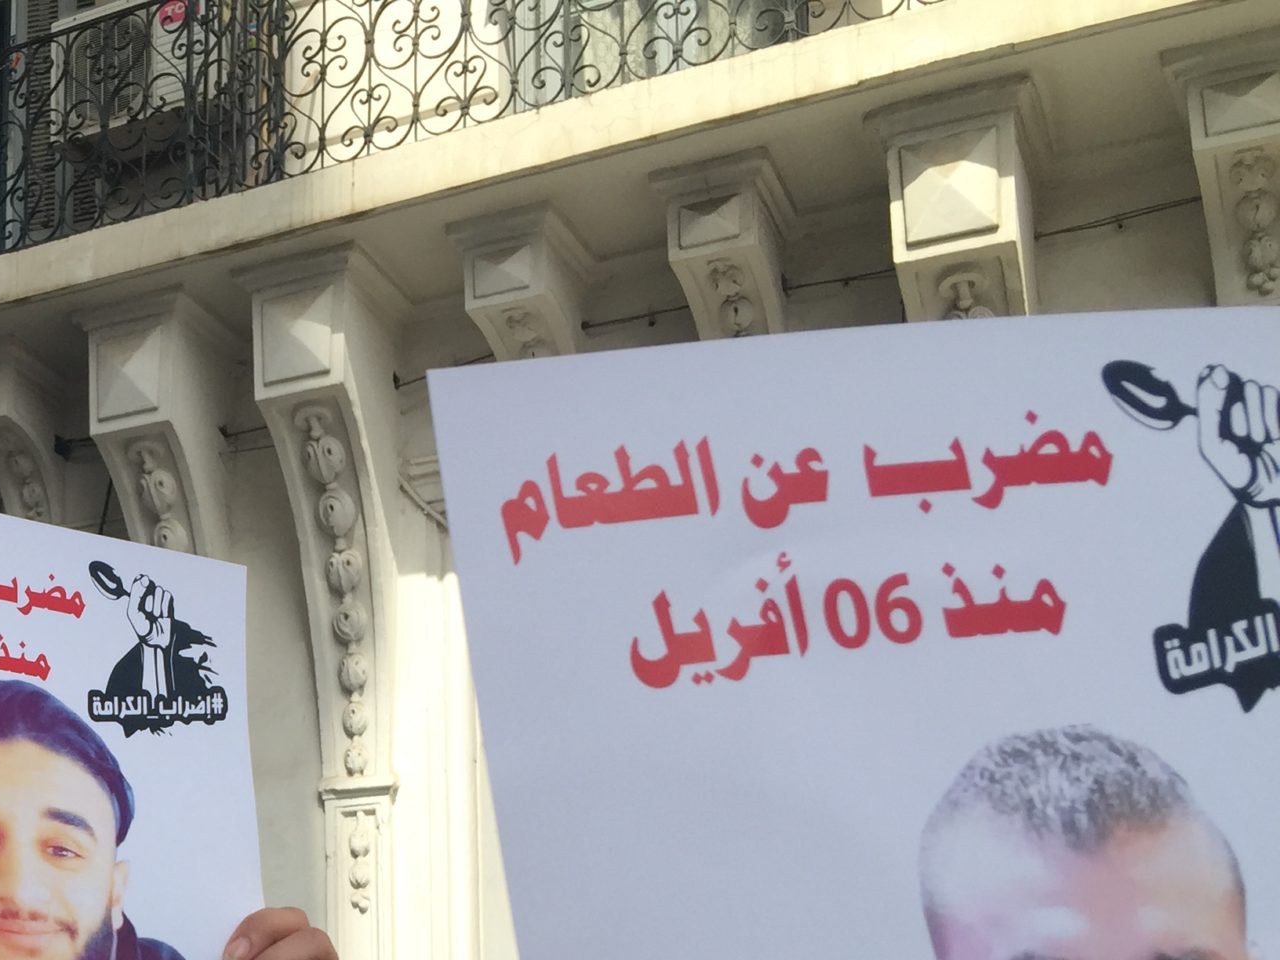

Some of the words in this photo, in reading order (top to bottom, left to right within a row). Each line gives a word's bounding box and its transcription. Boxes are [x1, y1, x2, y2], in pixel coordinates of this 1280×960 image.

[501, 436, 720, 565] الطعام
[741, 447, 829, 529] عن
[865, 411, 1113, 513] مضرب
[629, 551, 809, 690] أفريل
[823, 573, 924, 650] 06
[941, 563, 1066, 639] منذ
